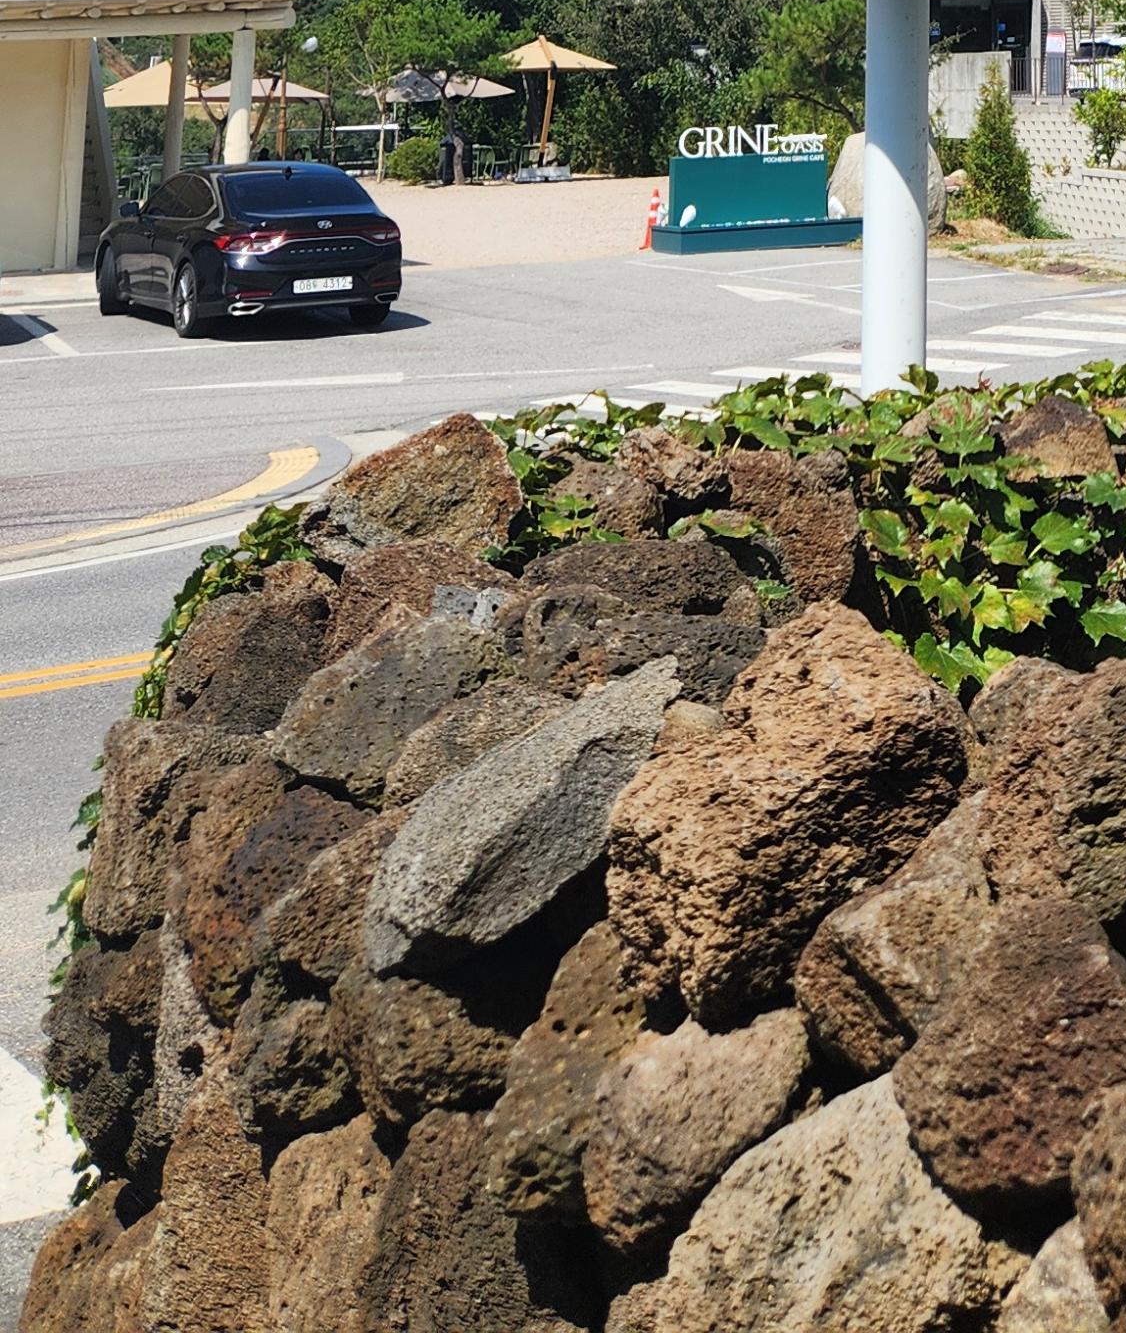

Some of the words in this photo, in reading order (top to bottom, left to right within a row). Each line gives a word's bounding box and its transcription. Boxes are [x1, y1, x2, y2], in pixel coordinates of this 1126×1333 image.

[679, 124, 779, 159] GRINE
[780, 139, 824, 154] OASIS
[809, 154, 825, 162] CAFE
[322, 276, 348, 289] 4312
